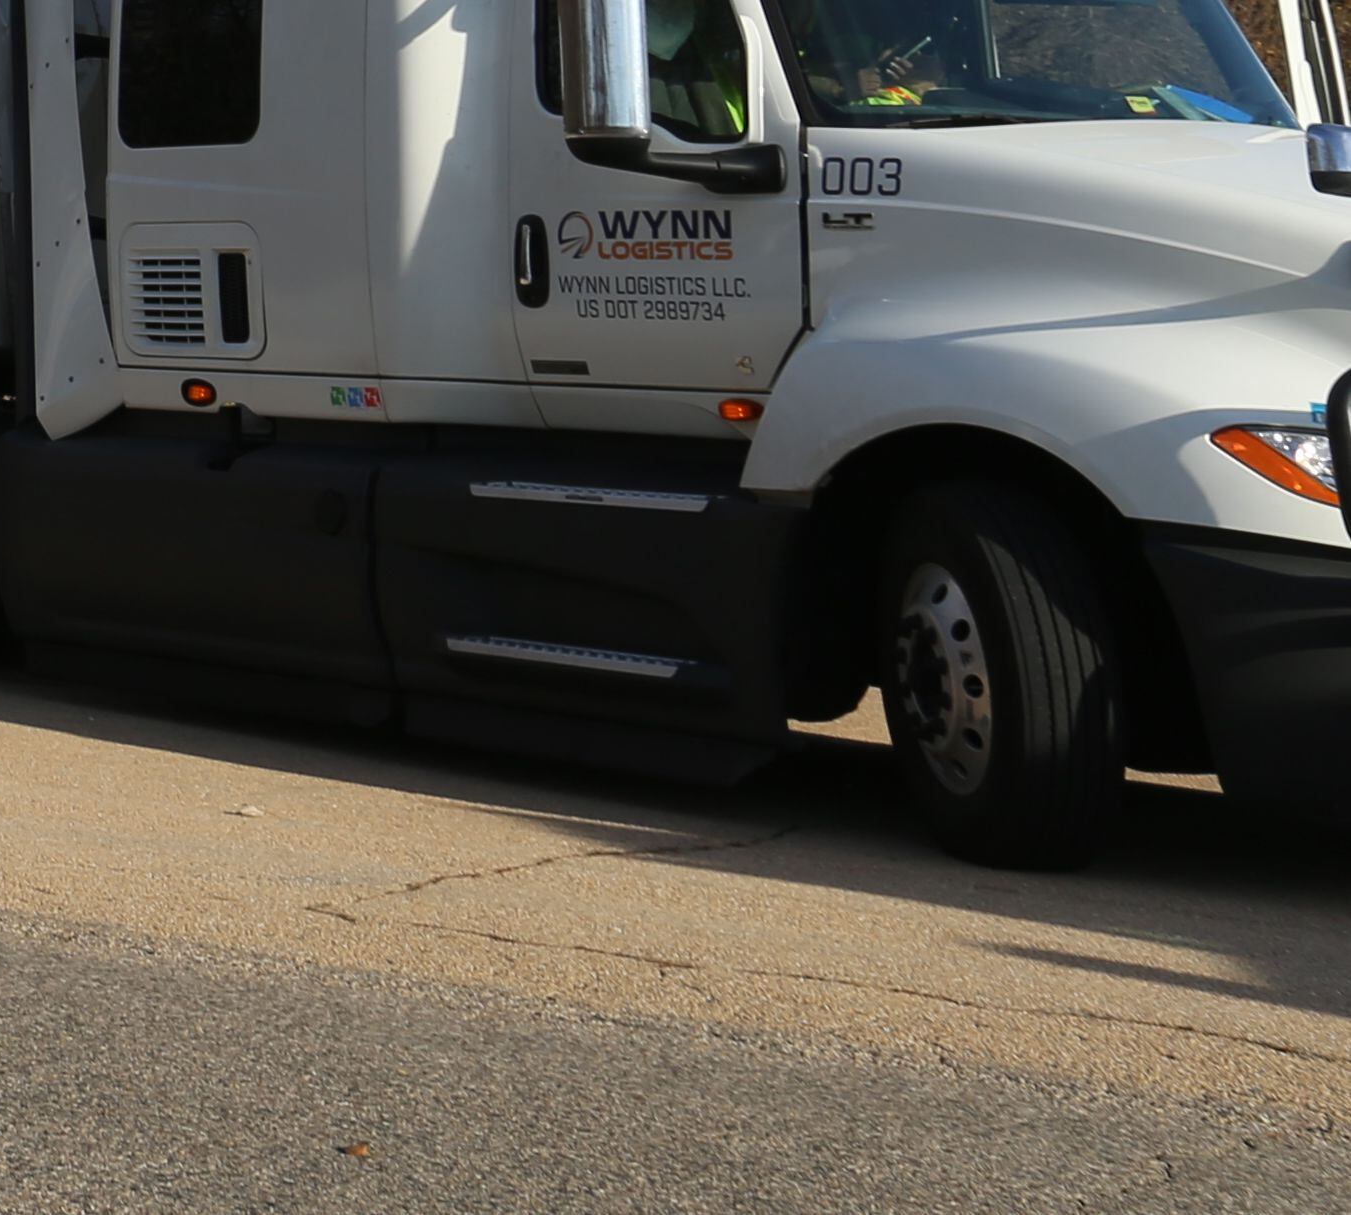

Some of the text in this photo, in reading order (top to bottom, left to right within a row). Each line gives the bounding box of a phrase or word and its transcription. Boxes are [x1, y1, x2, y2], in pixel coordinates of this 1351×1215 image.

[821, 156, 903, 196] 003
[599, 210, 732, 240] WYNN
[821, 212, 874, 227] LT
[598, 241, 734, 261] LOGISTICS
[558, 275, 751, 298] WYNN LOGISTICS LLC.
[576, 299, 726, 322] US DOT 2989734
